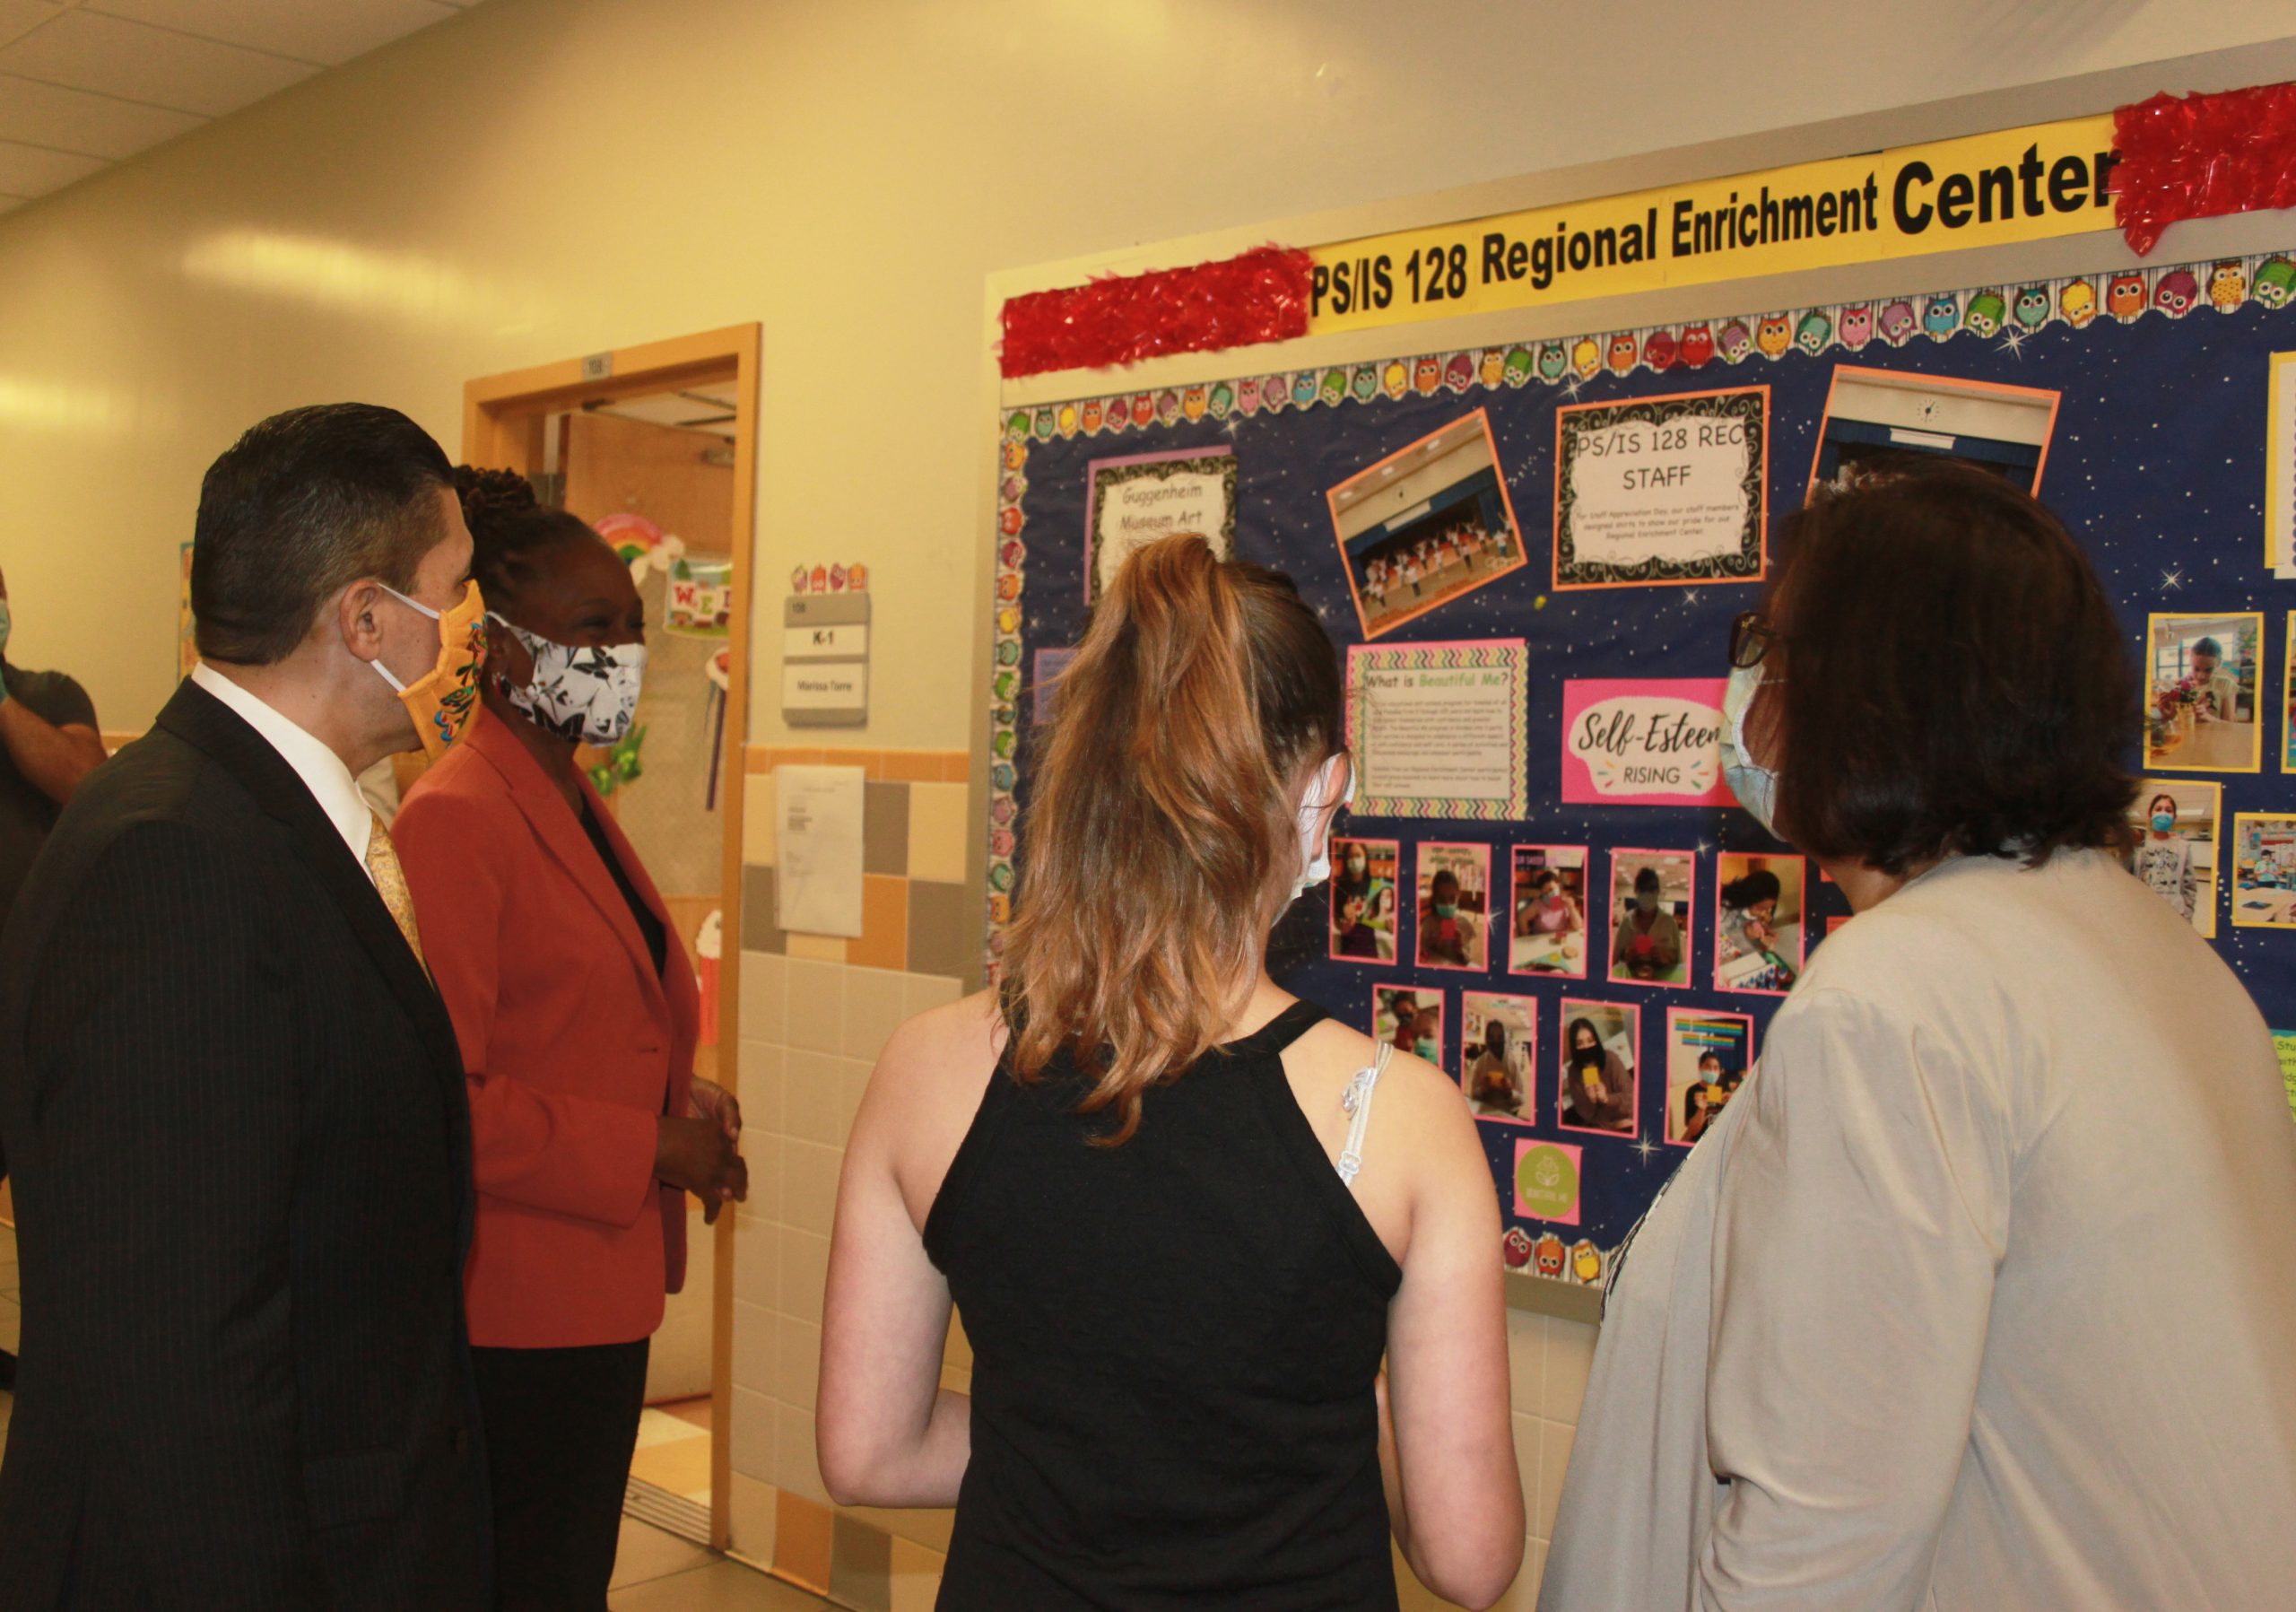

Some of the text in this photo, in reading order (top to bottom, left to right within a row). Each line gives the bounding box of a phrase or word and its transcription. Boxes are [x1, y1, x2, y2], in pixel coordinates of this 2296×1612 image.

[1311, 143, 2122, 317] PS/IS 128 Regional Enrichment Center
[1577, 424, 1744, 457] PS/IS 128 REC
[1622, 465, 1692, 491] STAFF
[1122, 483, 1203, 508] Guggenheim
[1120, 510, 1203, 531] Museum Art
[813, 629, 835, 646] K-1
[1366, 672, 1509, 688] What is Beautiful Me?
[1623, 765, 1681, 785] RISING
